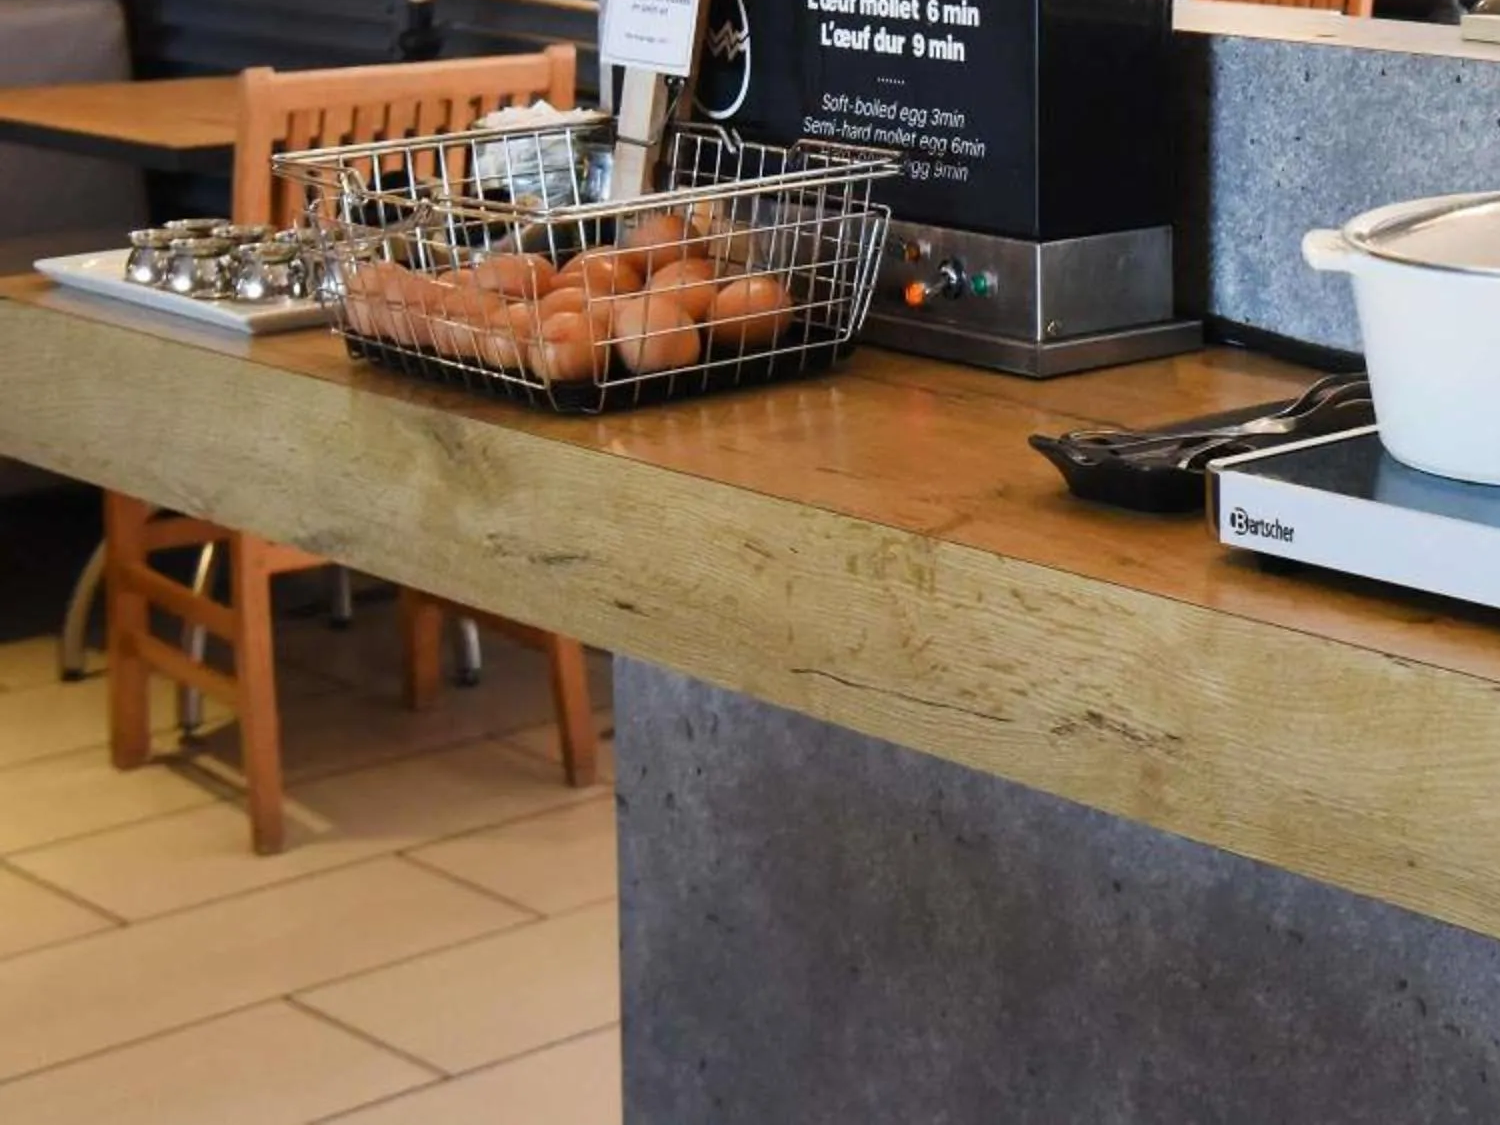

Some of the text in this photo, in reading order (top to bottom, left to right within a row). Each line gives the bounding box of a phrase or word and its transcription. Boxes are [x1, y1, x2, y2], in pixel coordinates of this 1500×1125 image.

[926, 0, 940, 23] 6
[943, 0, 981, 27] min
[873, 27, 906, 55] dur
[912, 33, 925, 57] 9
[929, 34, 966, 62] min
[821, 92, 966, 128] Soft-boiled egg 3min
[803, 116, 987, 157] Semi-hard mollet egg 6min
[932, 160, 970, 182] 9min
[1230, 506, 1295, 543] Bartscher
